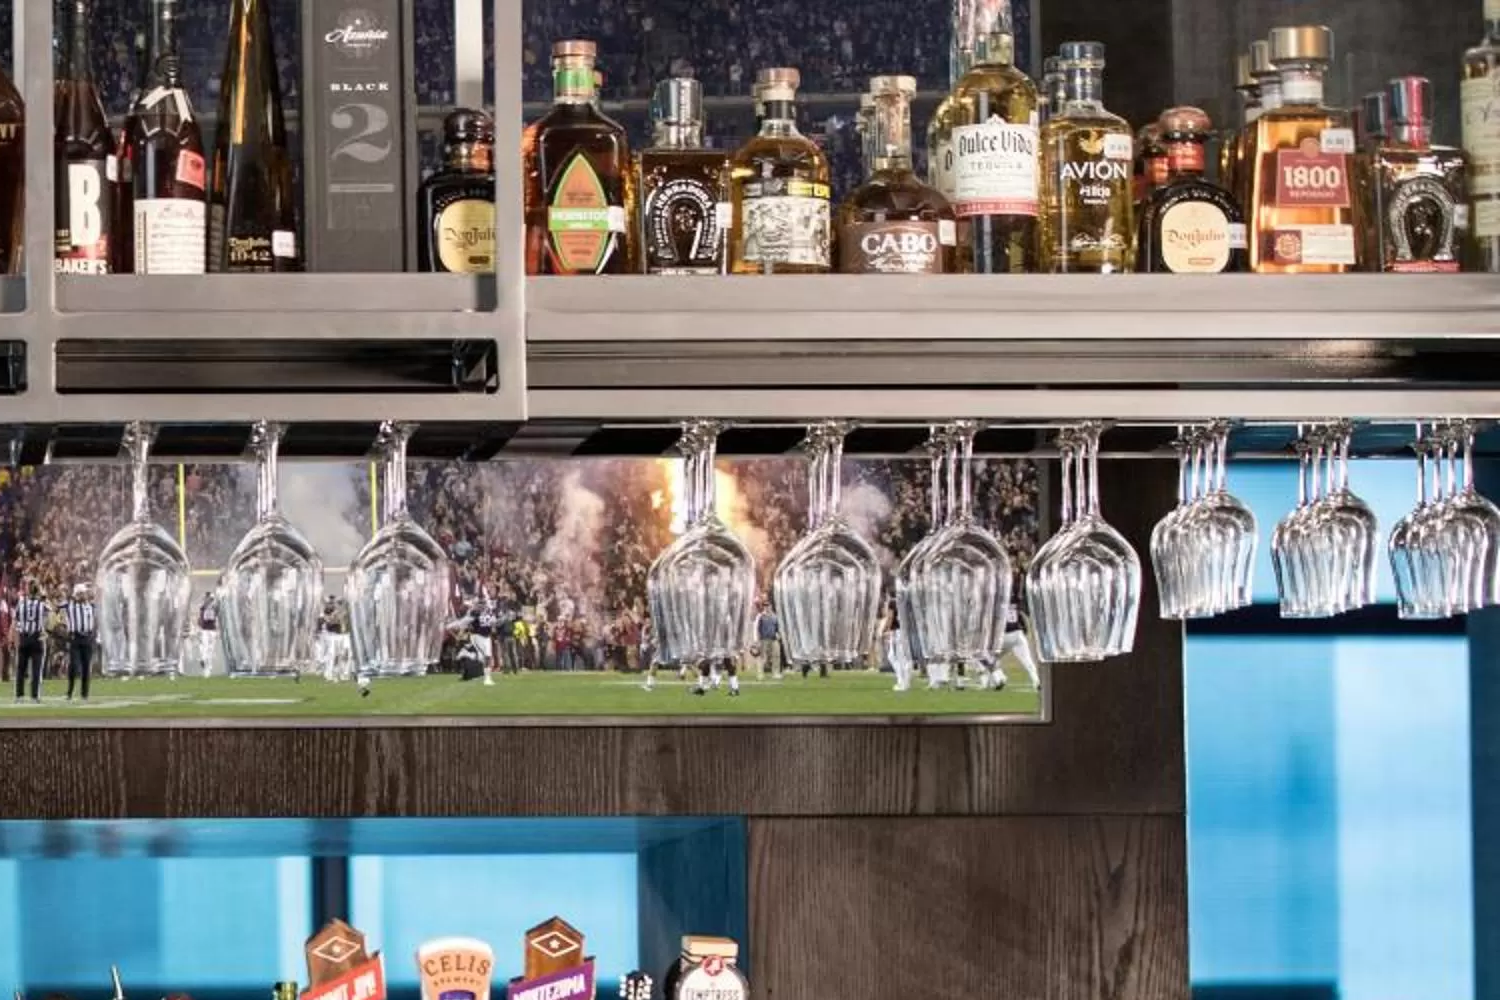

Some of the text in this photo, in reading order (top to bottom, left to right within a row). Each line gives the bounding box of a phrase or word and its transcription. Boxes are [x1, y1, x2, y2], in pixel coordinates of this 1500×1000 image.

[330, 83, 389, 91] BLACK
[330, 103, 393, 162] 2
[1283, 165, 1341, 188] 1800
[68, 163, 102, 246] B
[861, 232, 938, 254] CABO
[424, 954, 491, 977] CELIS
